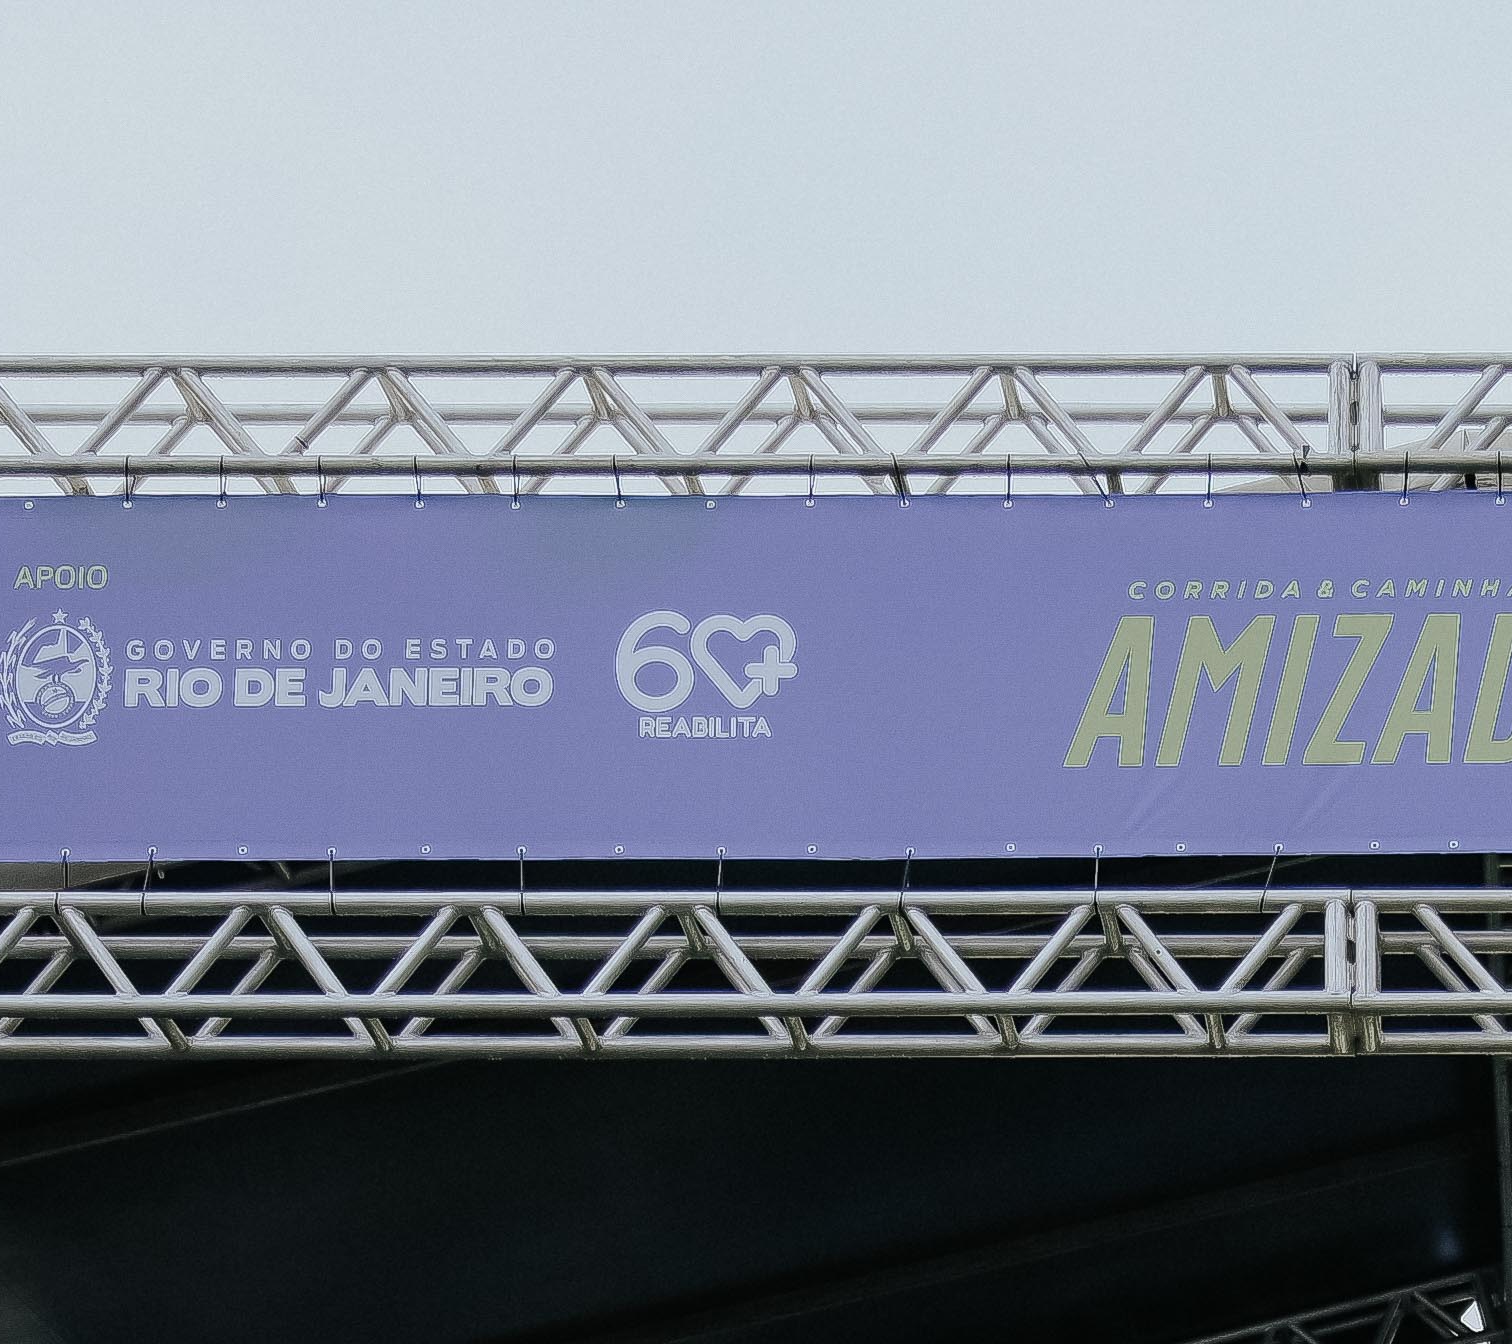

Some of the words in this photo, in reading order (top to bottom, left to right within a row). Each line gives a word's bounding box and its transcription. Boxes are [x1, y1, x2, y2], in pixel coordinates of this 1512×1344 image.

[12, 565, 109, 592] APOIO
[1127, 579, 1301, 600] CORRIDA
[1317, 579, 1335, 599] &
[124, 638, 313, 662] GOVERNO
[335, 637, 385, 662] DO
[404, 637, 558, 661] ESTADO
[123, 667, 224, 709] RIO
[233, 667, 307, 708] DE
[318, 666, 555, 708] JANEIRO
[638, 714, 773, 740] REABILITA
